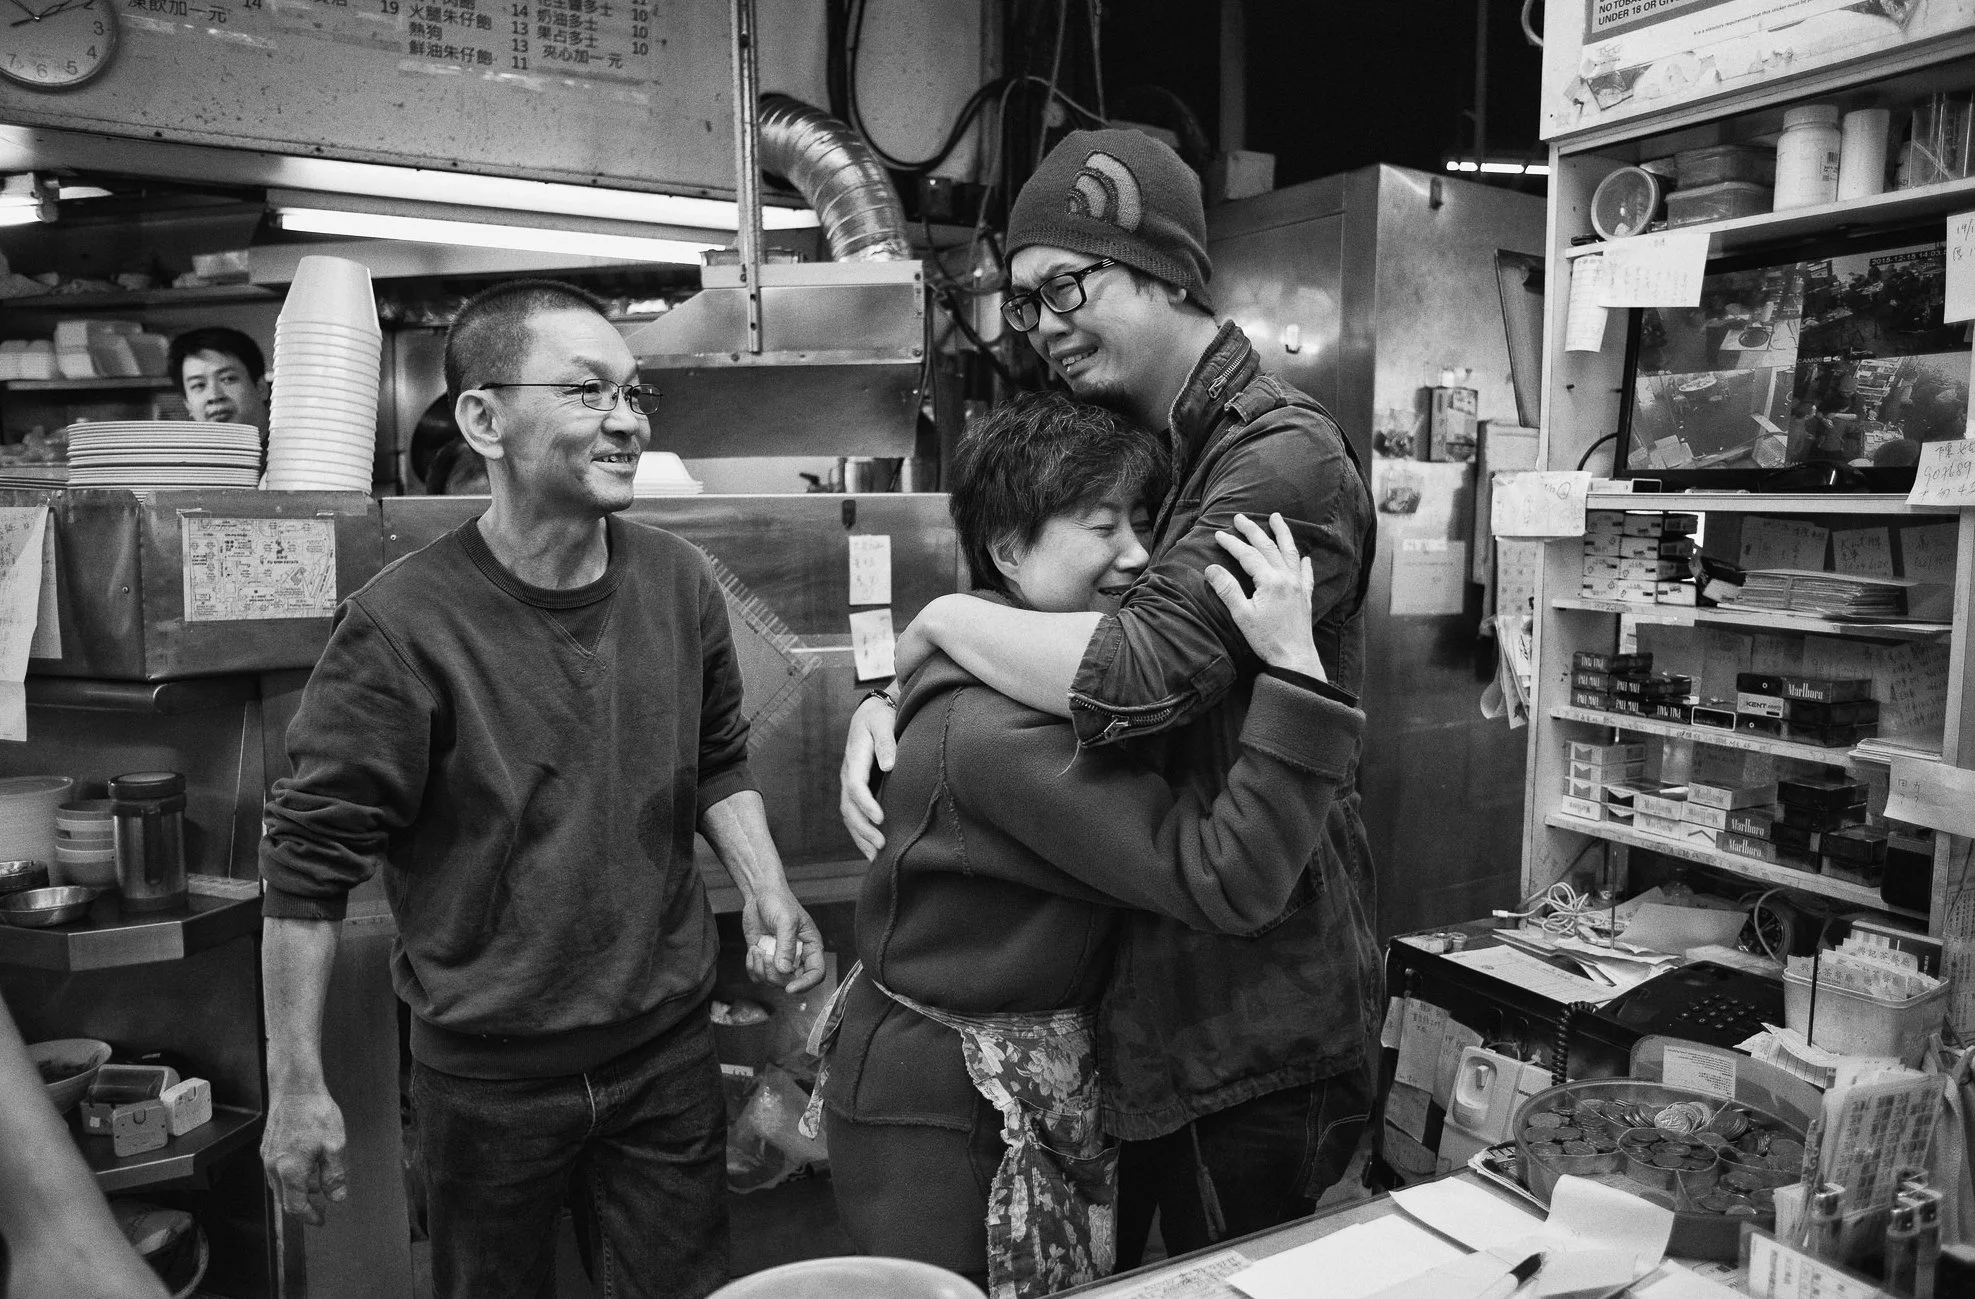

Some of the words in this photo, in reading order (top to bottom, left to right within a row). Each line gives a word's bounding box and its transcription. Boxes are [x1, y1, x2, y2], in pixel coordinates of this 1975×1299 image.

[381, 0, 399, 15] 19
[512, 3, 528, 17] 14
[632, 8, 648, 22] 10
[1598, 8, 1629, 25] UNDER
[1632, 5, 1641, 15] 18
[1643, 1, 1656, 11] OR
[1599, 3, 1613, 14] NO
[93, 21, 104, 36] 3
[512, 21, 528, 36] 13
[632, 25, 648, 39] 10
[87, 45, 97, 60] 4
[512, 39, 528, 53] 13
[632, 42, 648, 56] 10
[7, 53, 17, 68] 7
[64, 60, 78, 75] 5
[512, 56, 528, 70] 11
[37, 64, 48, 78] 6
[1788, 683, 1824, 699] Marlboro
[1746, 701, 1767, 709] KENT
[1731, 818, 1765, 837] Marlboro
[1728, 839, 1763, 857] Marlboro
